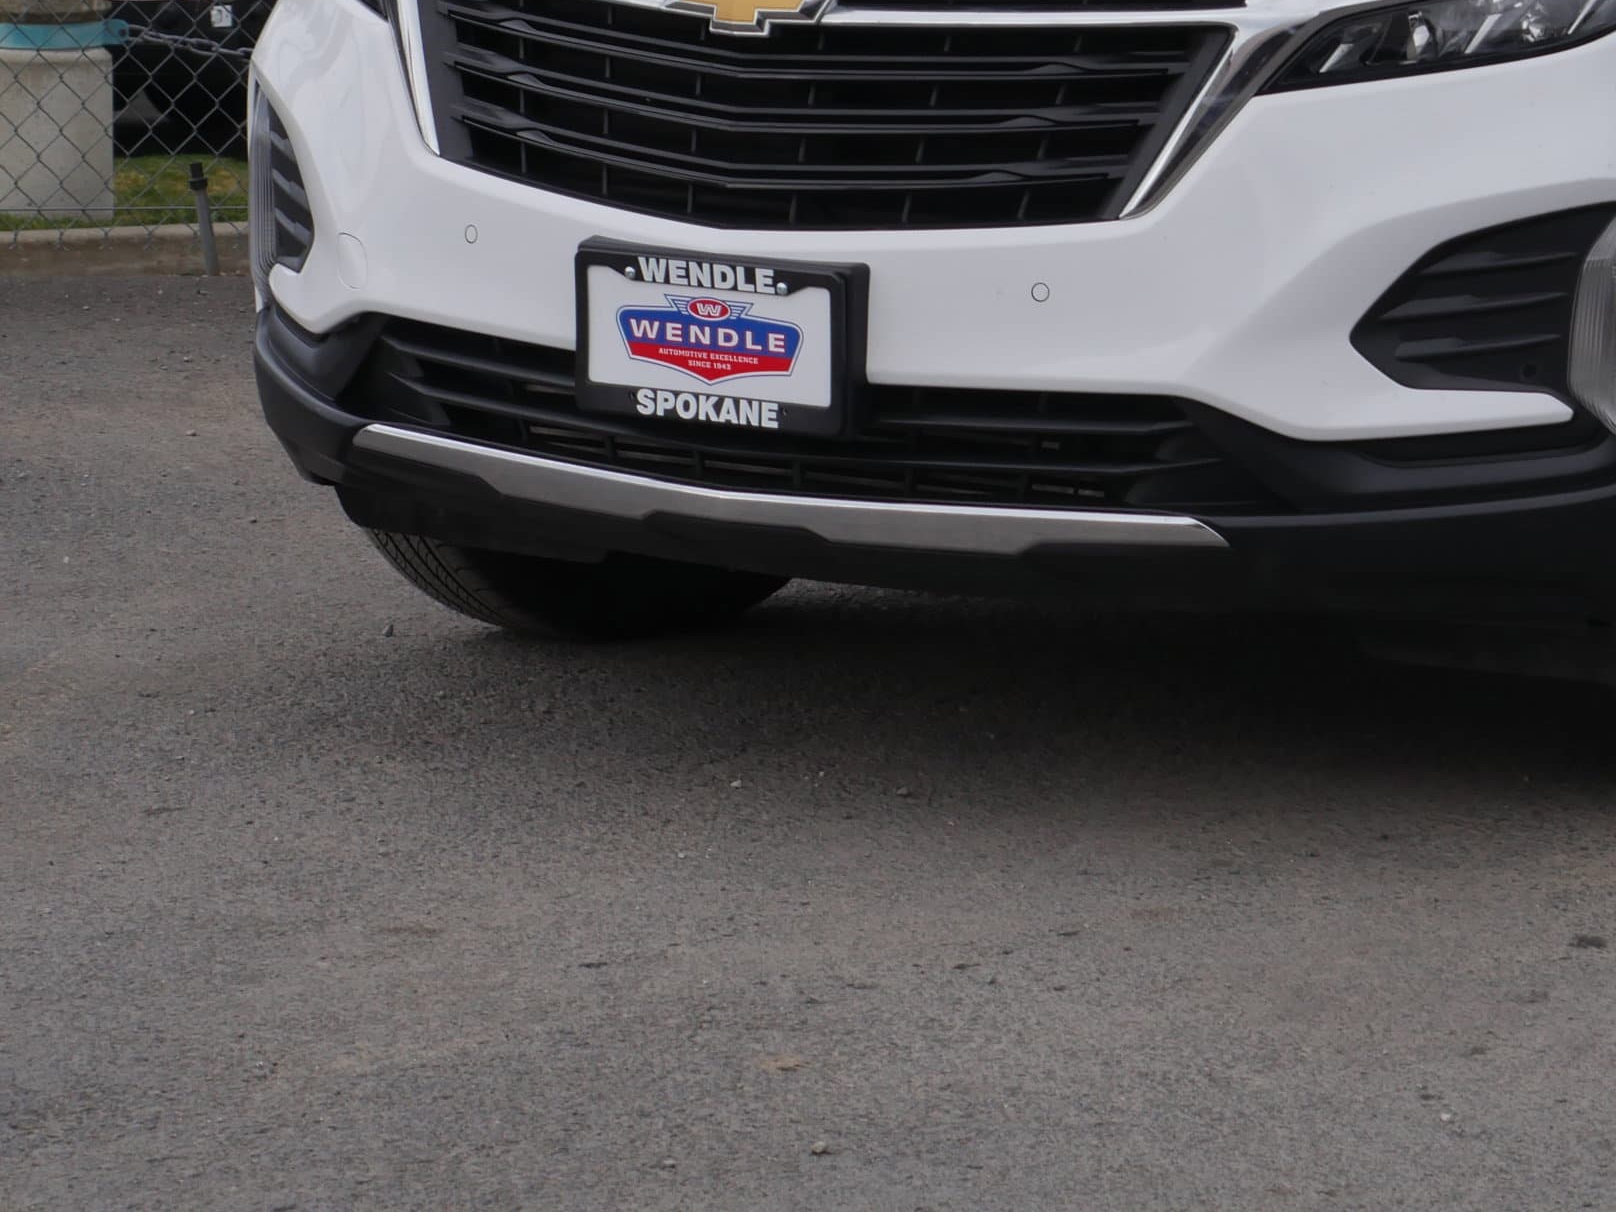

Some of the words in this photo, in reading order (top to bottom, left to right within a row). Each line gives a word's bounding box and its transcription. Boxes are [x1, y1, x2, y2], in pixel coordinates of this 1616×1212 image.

[637, 256, 776, 295] WENDLE
[629, 318, 786, 354] WENDLE
[658, 347, 708, 360] AUTOMOTIVE
[710, 352, 759, 365] EXCELLENCE
[687, 359, 712, 369] SINCE
[713, 361, 732, 371] 1943
[635, 388, 780, 429] SPOKANE
